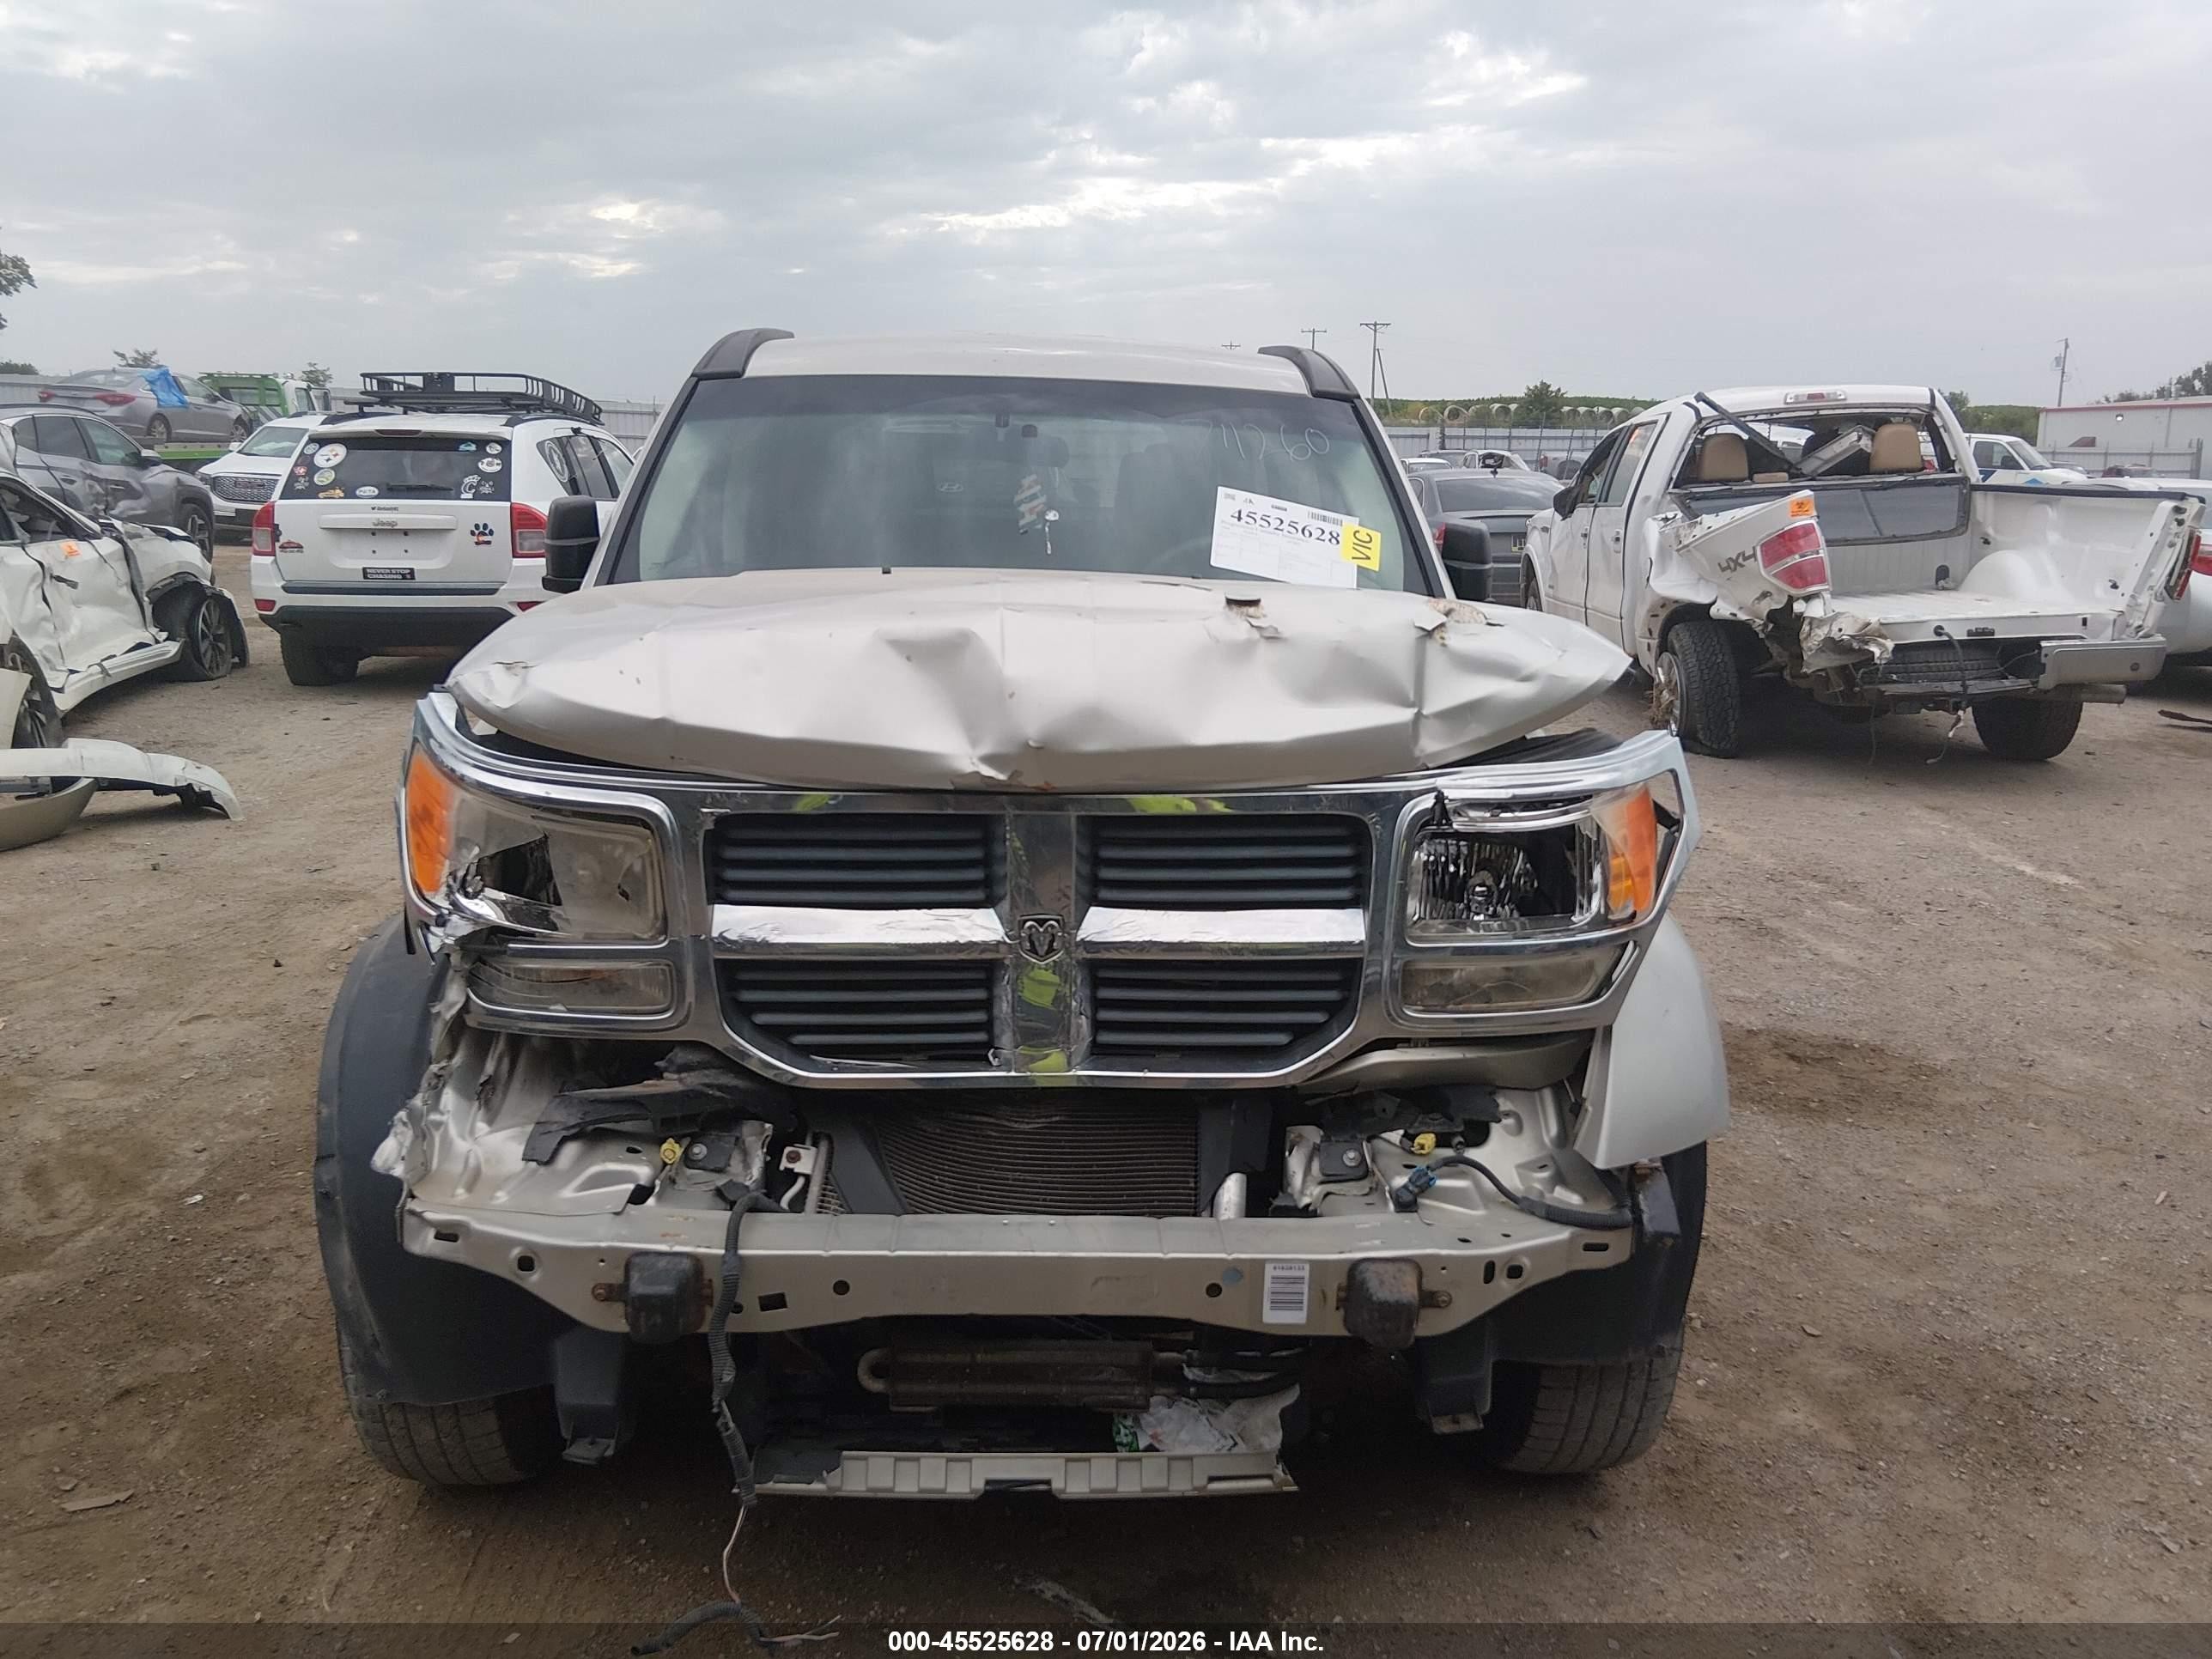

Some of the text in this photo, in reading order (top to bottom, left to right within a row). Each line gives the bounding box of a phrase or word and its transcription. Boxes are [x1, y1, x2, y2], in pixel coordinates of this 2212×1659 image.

[373, 518, 398, 528] Jeep
[1231, 508, 1340, 545] 45525628
[1352, 530, 1372, 561] VIC
